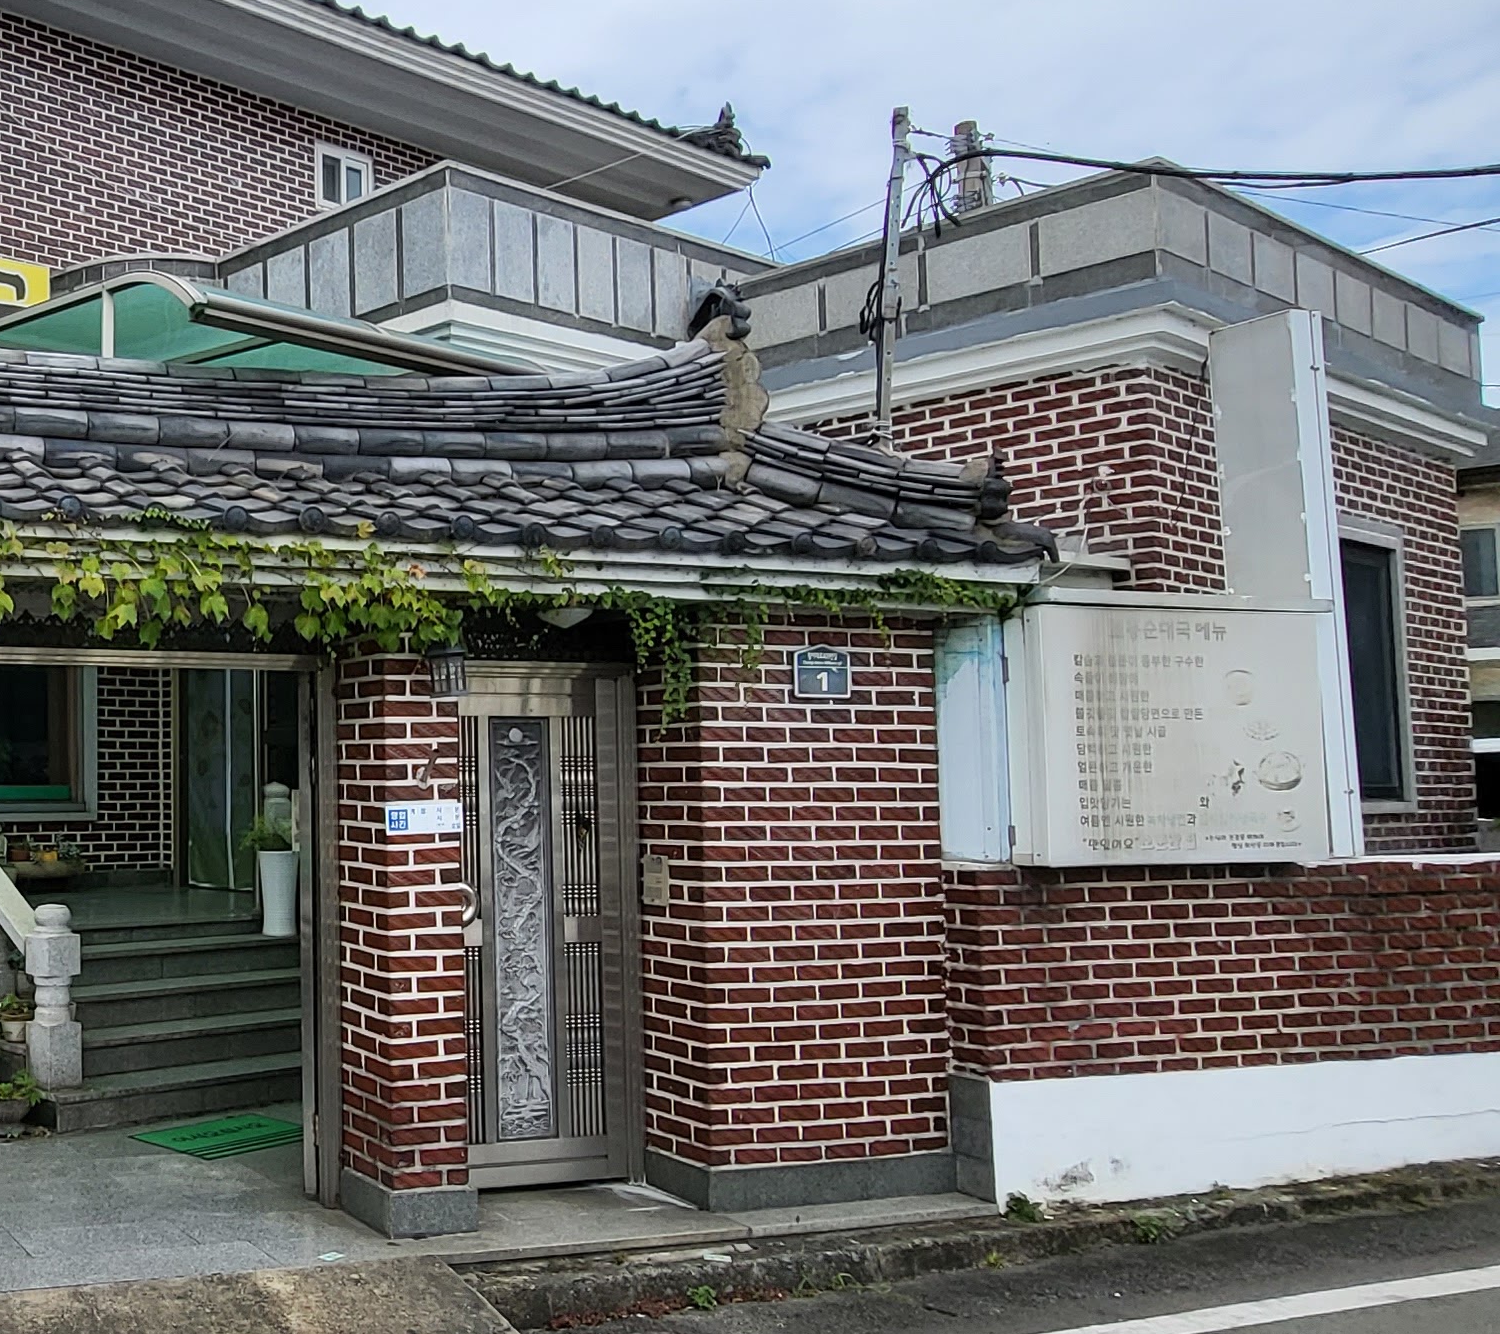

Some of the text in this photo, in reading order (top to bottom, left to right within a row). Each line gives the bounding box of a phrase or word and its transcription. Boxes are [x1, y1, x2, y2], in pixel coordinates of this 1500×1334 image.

[1195, 620, 1228, 642] 메뉴
[1174, 655, 1205, 668] 구수한
[816, 671, 828, 692] 1
[1199, 796, 1210, 809] 와
[1115, 814, 1145, 827] 시원한
